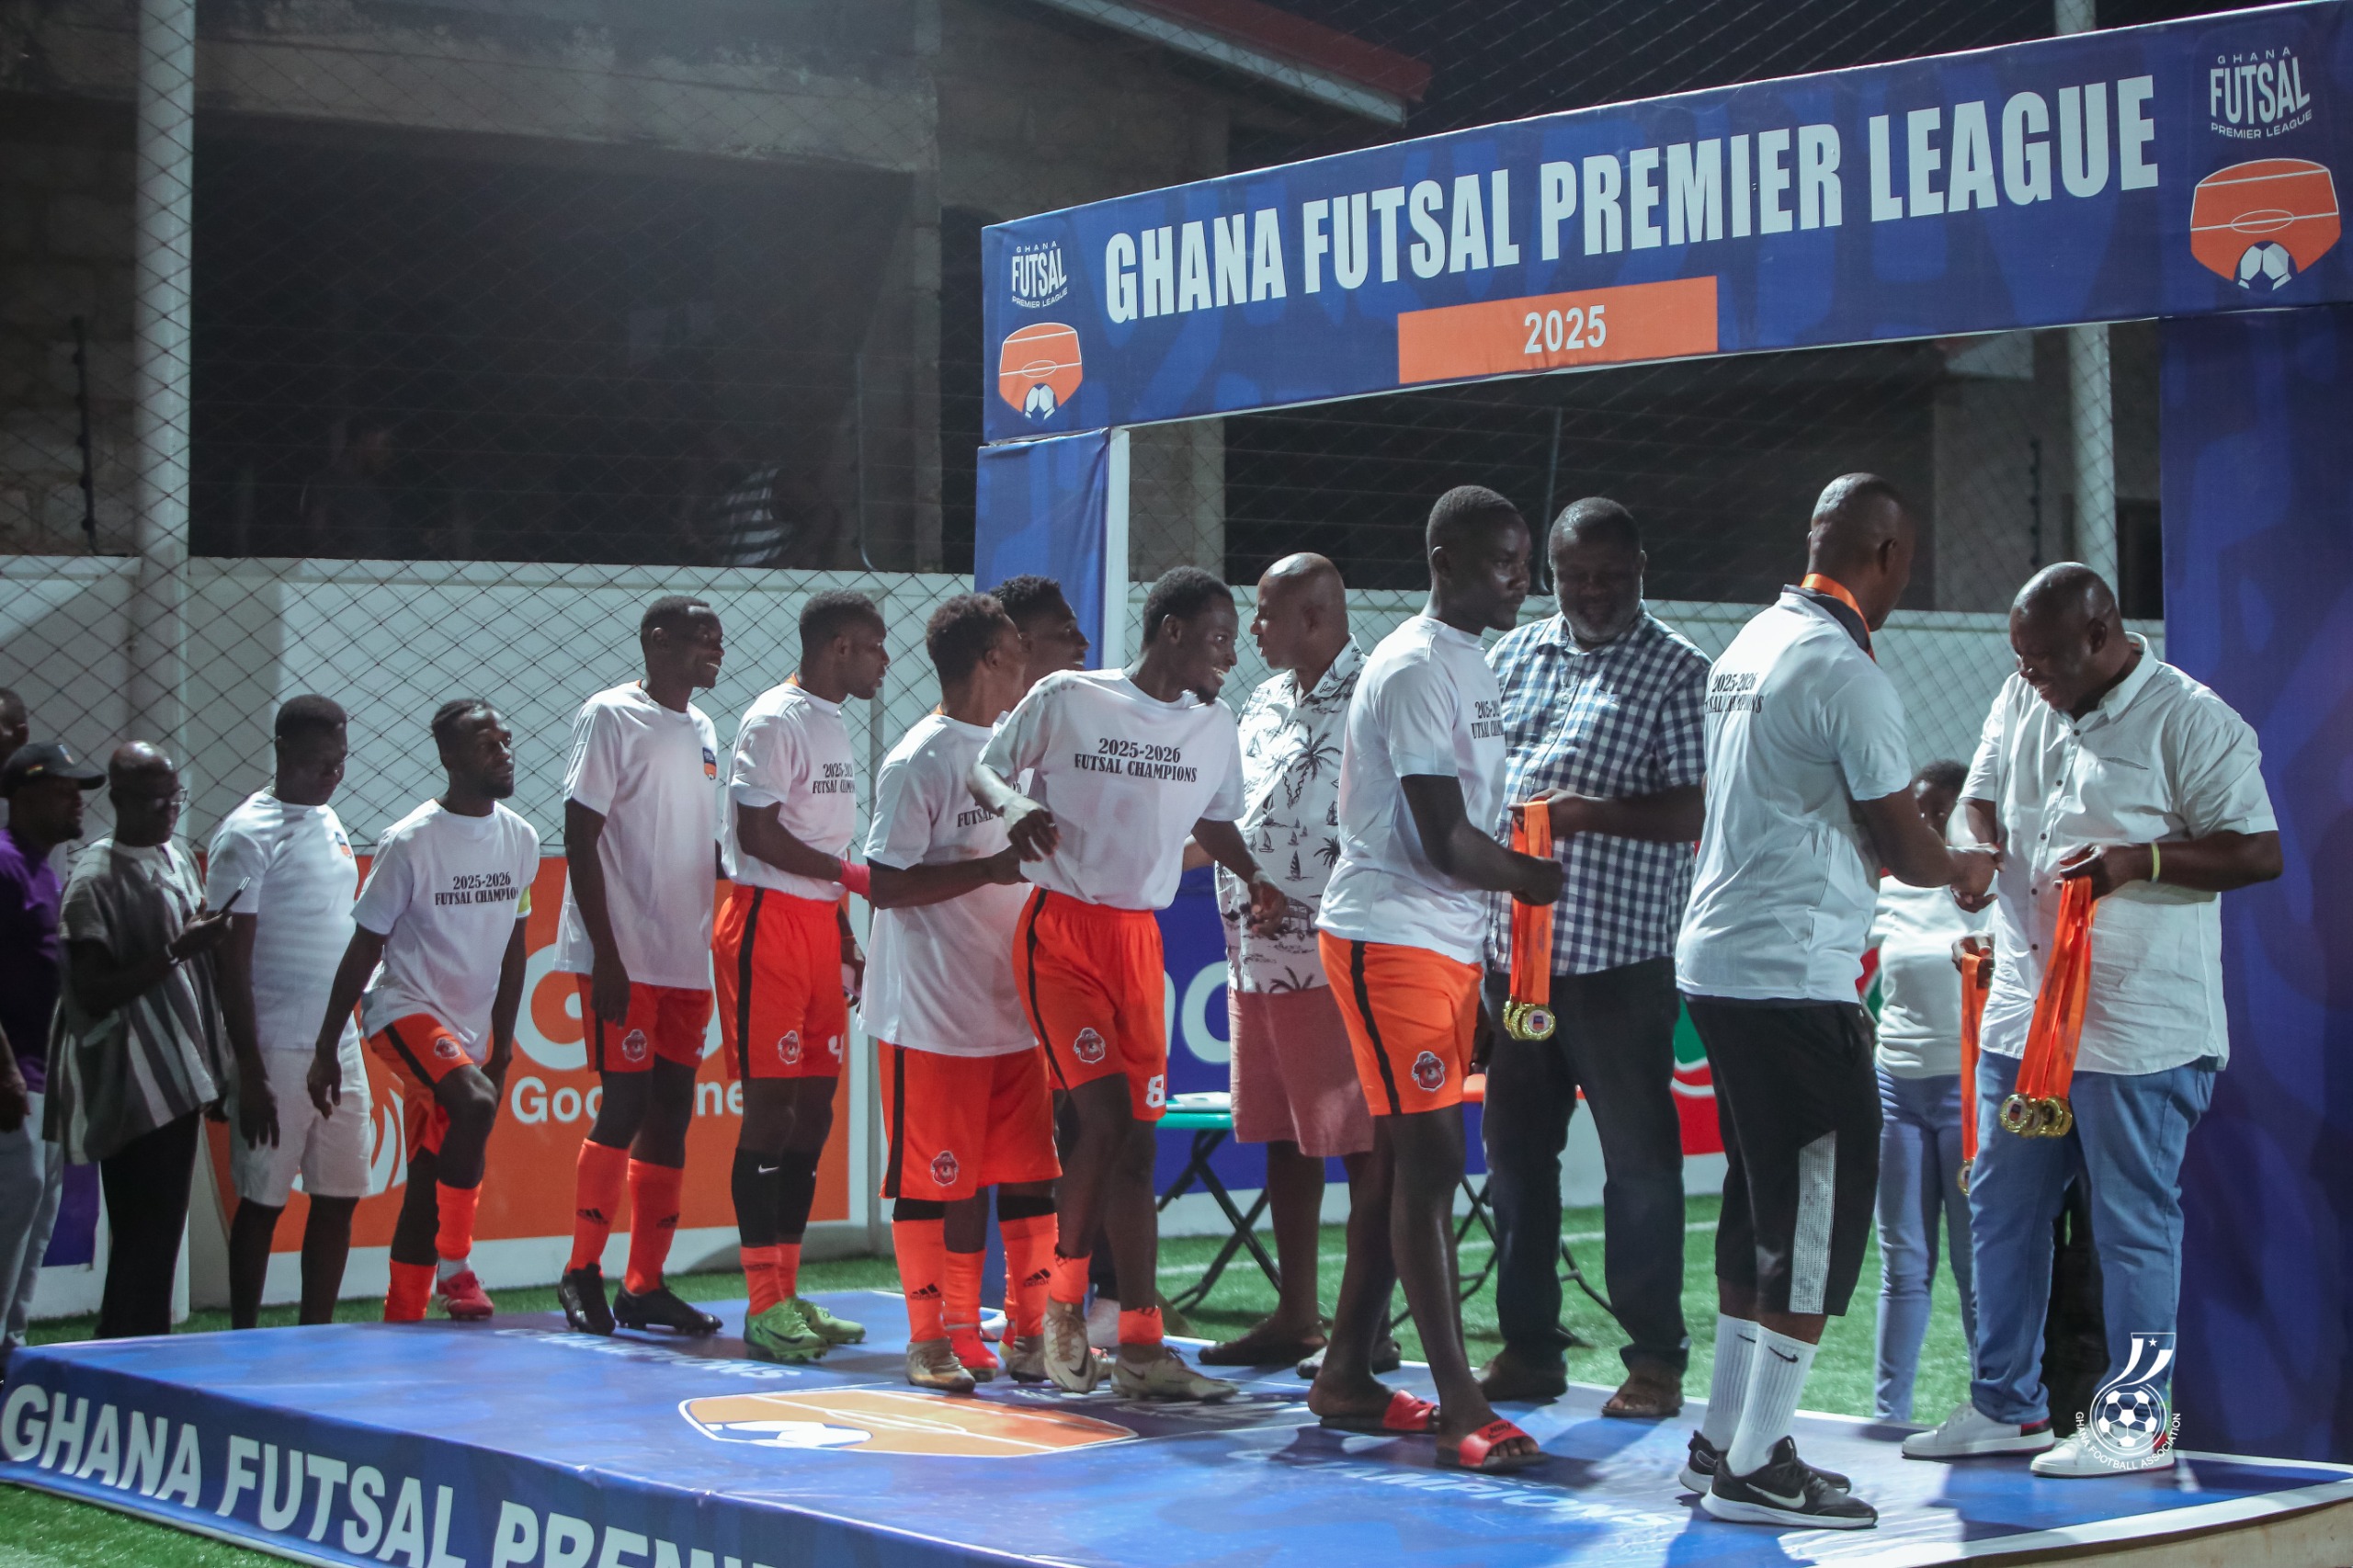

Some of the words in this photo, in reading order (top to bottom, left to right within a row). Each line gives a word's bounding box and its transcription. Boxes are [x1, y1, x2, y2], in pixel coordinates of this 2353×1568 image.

[2218, 46, 2291, 64] GHANA
[2211, 57, 2310, 124] FUTSAL
[2211, 122, 2261, 139] PREMIER
[2266, 109, 2313, 138] LEAGUE
[1105, 208, 1286, 324] GHANA
[1303, 169, 1519, 293] FUTSAL
[1540, 124, 1842, 261] PREMIER
[1870, 75, 2158, 222] LEAGUE
[1016, 240, 1057, 253] GHANA
[1012, 248, 1066, 298] FUTSAL
[1012, 295, 1040, 308] PREMIER
[1042, 287, 1068, 308] LEAGUE
[1524, 304, 1606, 354] 2025
[1098, 737, 1181, 764] 2025-2026
[1074, 754, 1122, 774] FUTSAL
[1128, 760, 1198, 782] CHAMPIONS
[435, 891, 472, 905] FUTSAL
[475, 886, 519, 903] CHAMPIO
[453, 871, 512, 891] 2025-2026
[1146, 1074, 1165, 1108] 8
[1, 1383, 202, 1508] GHANA
[215, 1435, 467, 1568] FUTSAL
